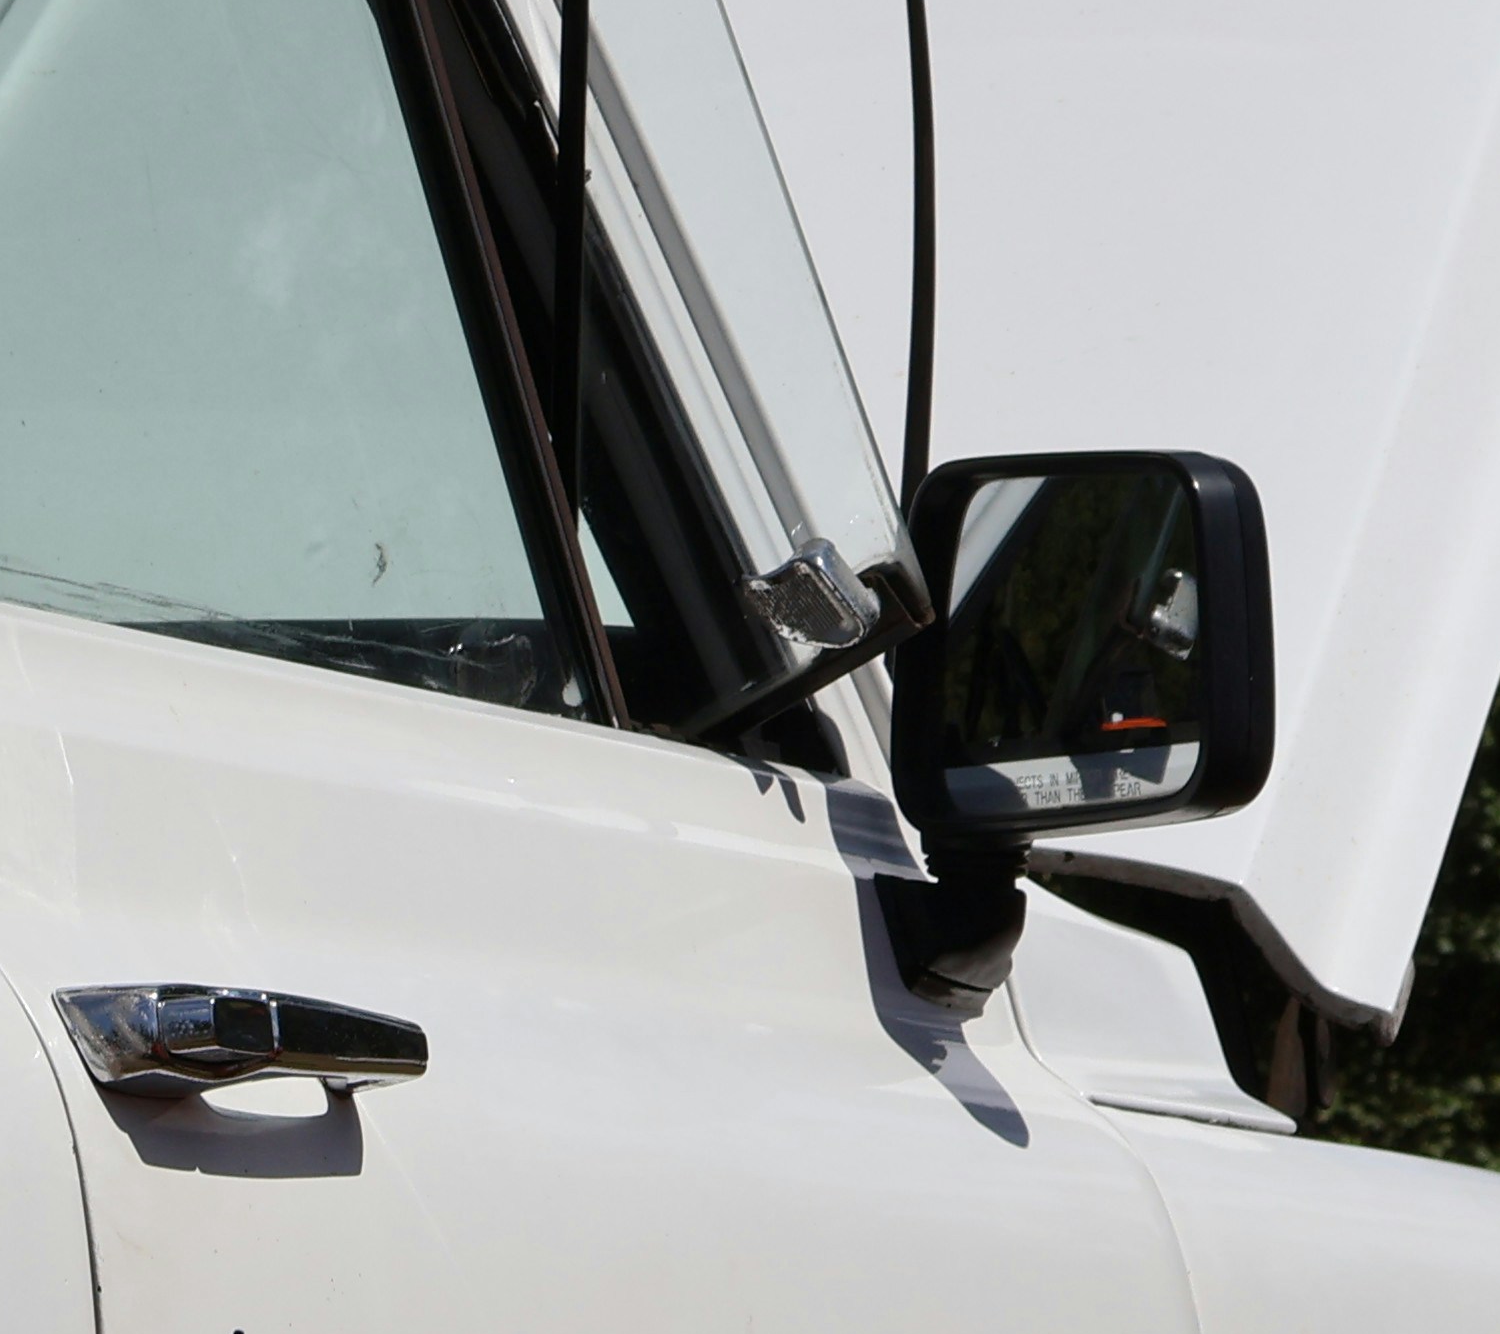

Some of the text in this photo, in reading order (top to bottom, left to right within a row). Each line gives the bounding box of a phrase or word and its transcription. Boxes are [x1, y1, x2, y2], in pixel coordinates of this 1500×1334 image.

[1049, 772, 1059, 787] IN
[1034, 789, 1061, 805] THAN
[1114, 782, 1141, 798] PEAR
